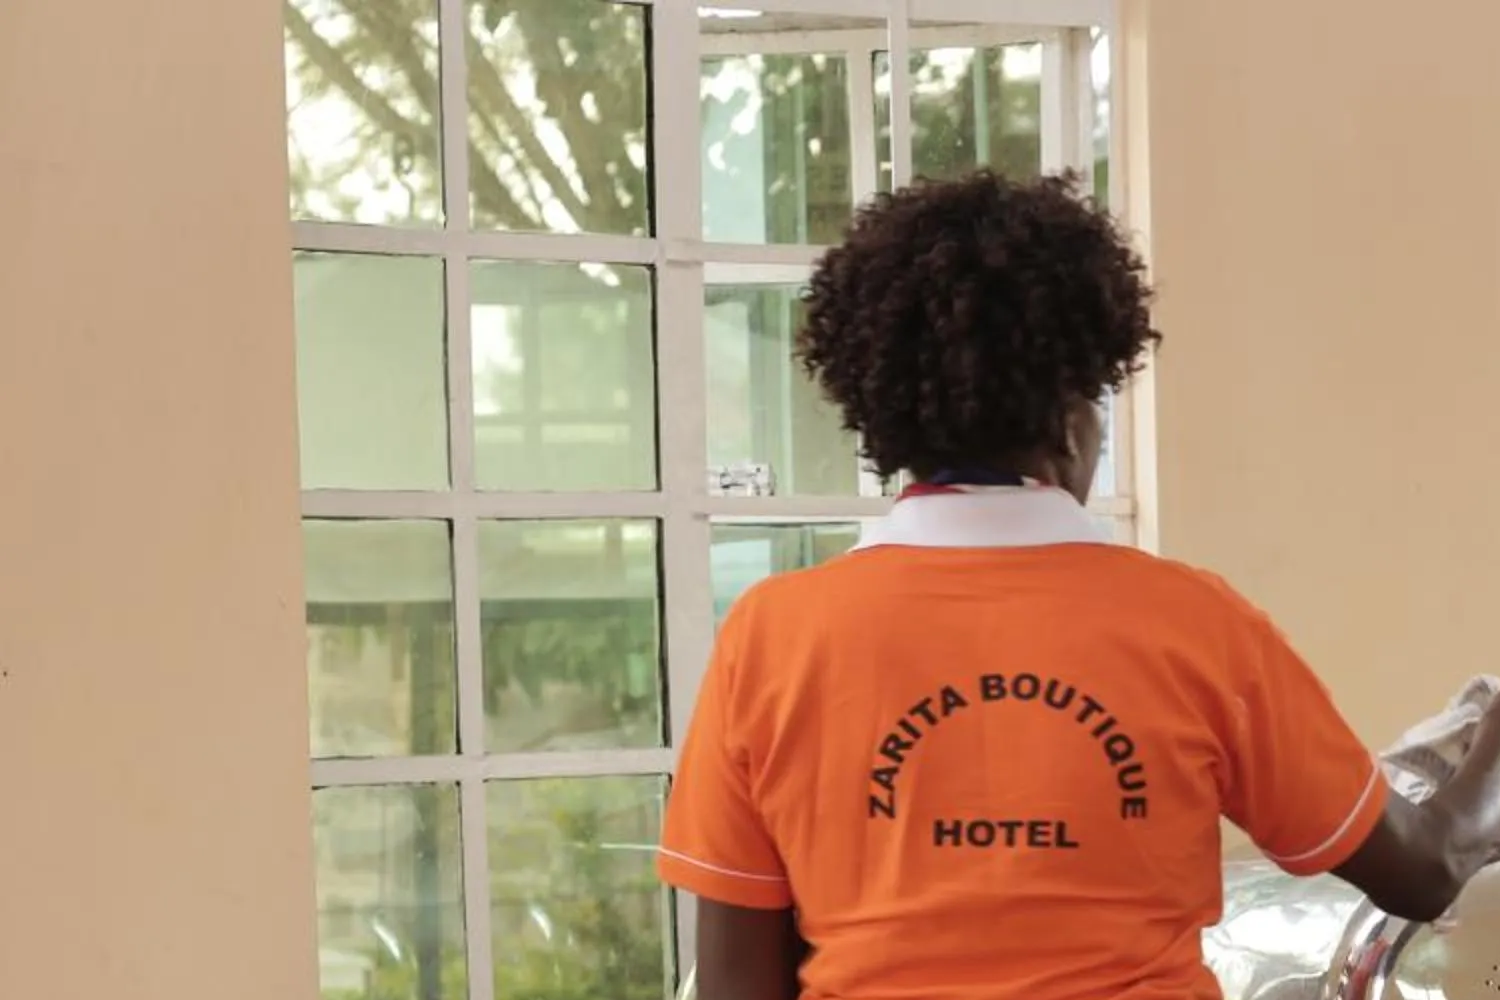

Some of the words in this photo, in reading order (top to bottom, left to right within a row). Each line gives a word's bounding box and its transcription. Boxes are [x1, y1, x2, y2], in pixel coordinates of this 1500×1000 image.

[868, 685, 968, 819] ZARITA
[979, 673, 1147, 820] BOUTIQUE
[933, 819, 1079, 848] HOTEL
